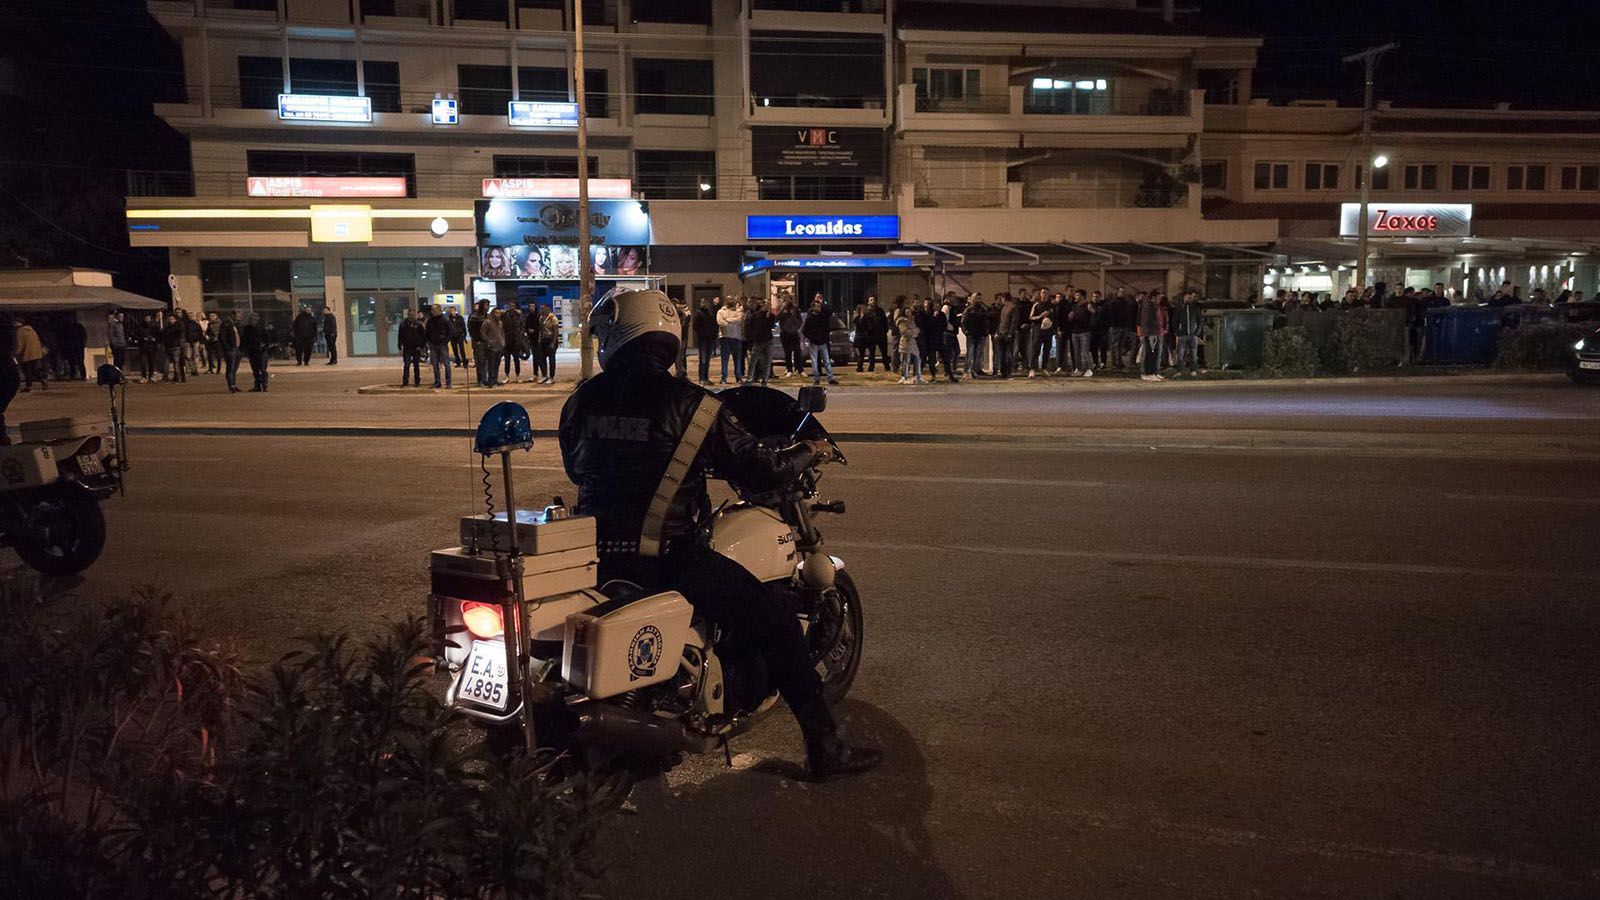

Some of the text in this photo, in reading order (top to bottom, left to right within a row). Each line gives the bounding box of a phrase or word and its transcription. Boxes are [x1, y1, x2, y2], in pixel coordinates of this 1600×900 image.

[798, 130, 837, 144] VMC
[268, 178, 302, 188] ASPIS
[502, 179, 533, 189] ASPIS
[268, 188, 323, 197] Real Estate
[785, 219, 863, 235] Leonidas
[1374, 209, 1438, 231] Zaxos
[585, 416, 650, 441] POLICE
[464, 677, 503, 704] 4895
